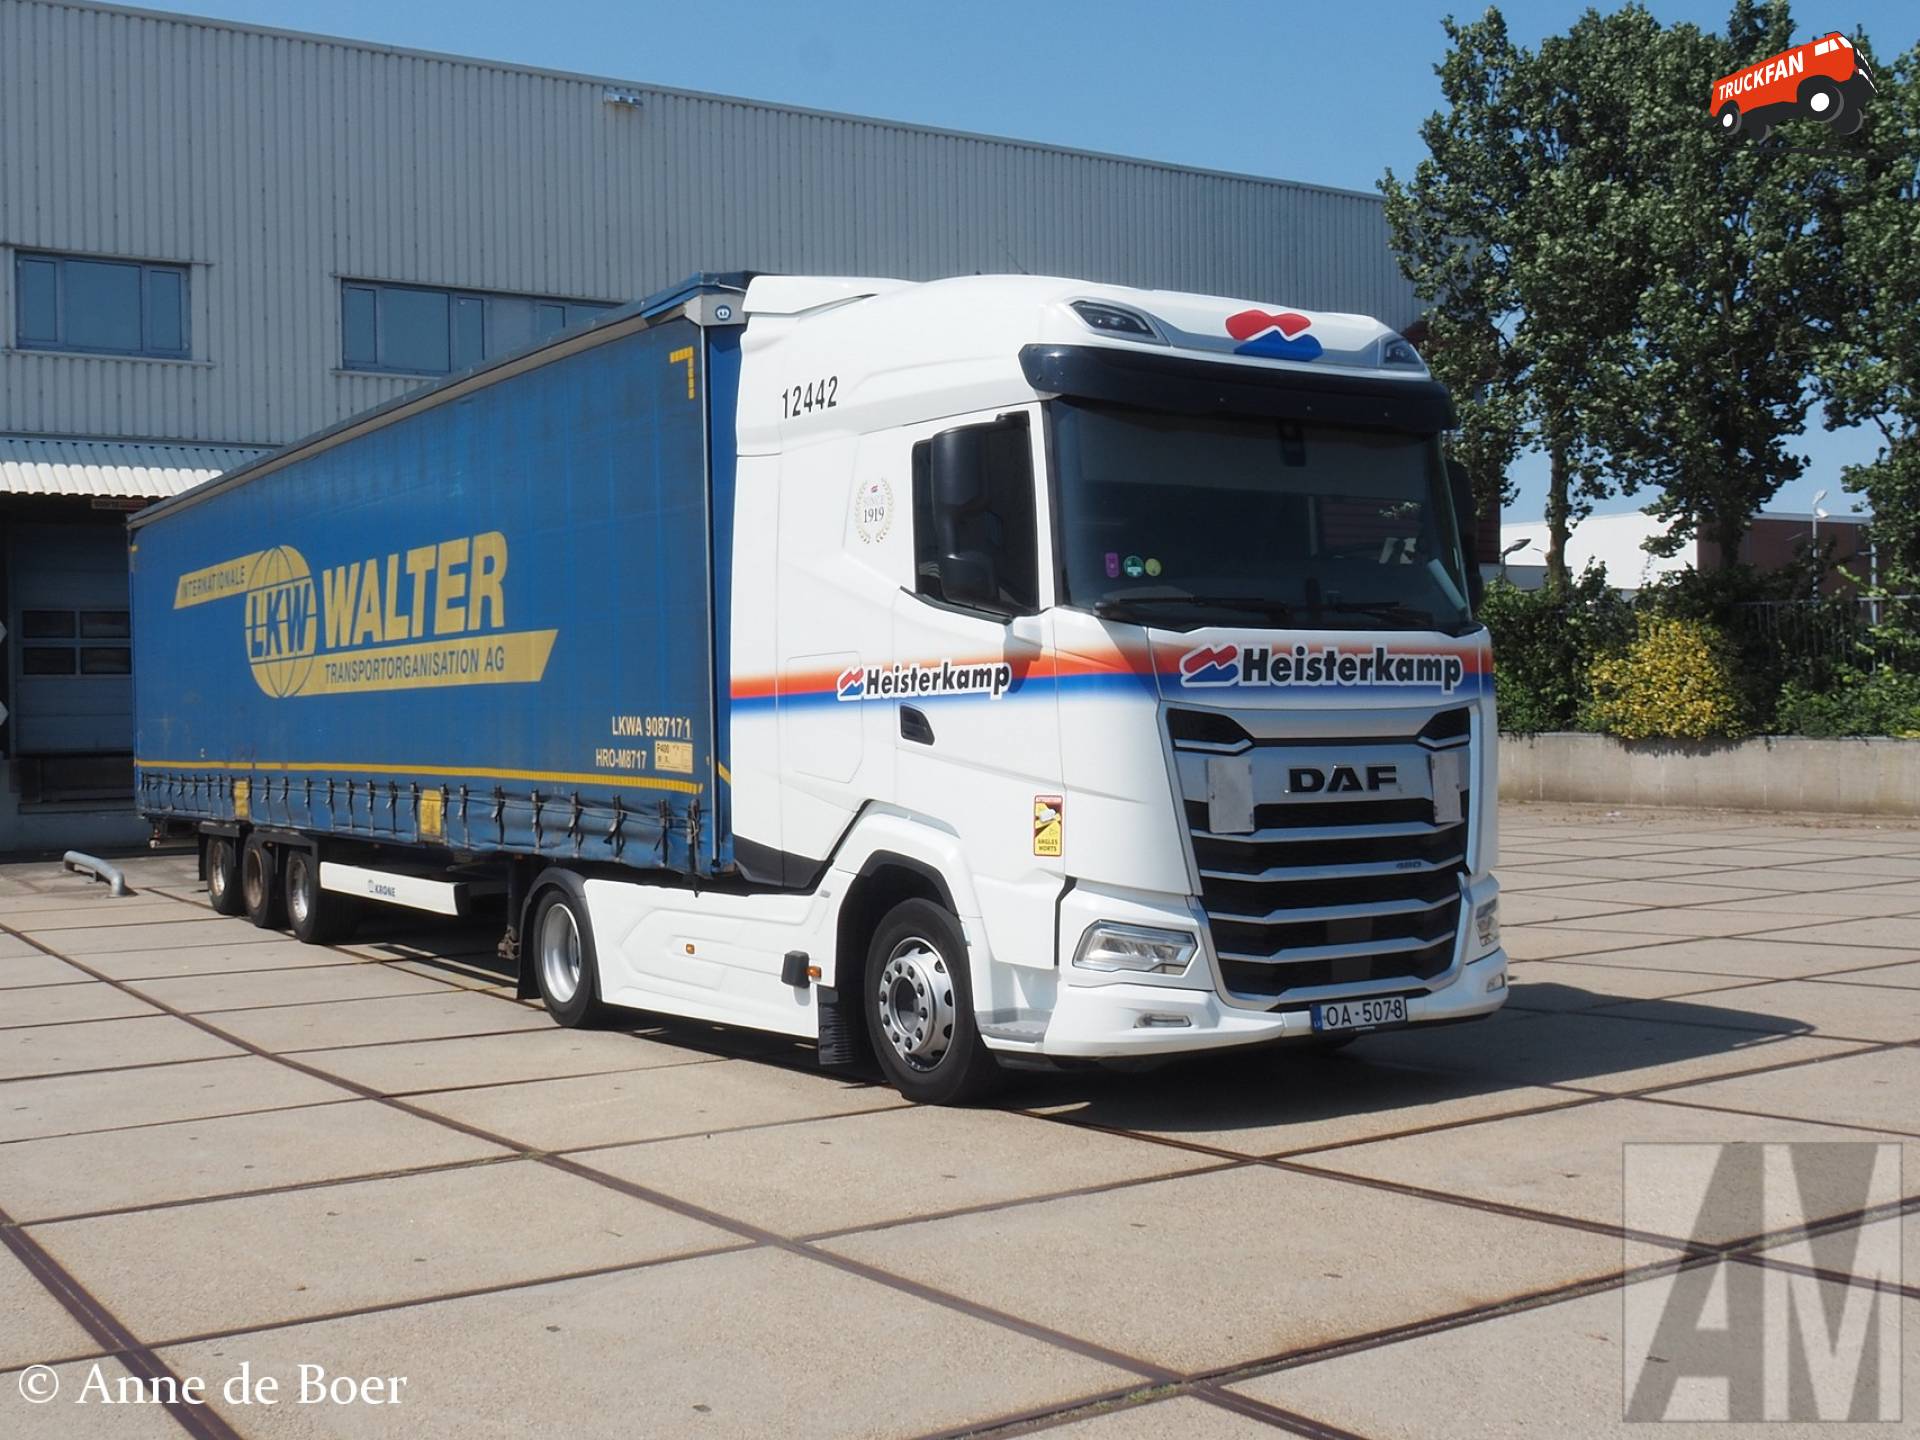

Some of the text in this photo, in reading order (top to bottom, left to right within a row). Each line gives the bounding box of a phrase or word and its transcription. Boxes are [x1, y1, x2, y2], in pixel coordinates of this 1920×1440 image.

[781, 376, 838, 419] 12442
[864, 507, 884, 523] 1919
[180, 564, 245, 598] INTERNATIONALE
[322, 530, 507, 649] WALTER
[251, 582, 311, 658] LKW
[325, 646, 504, 684] TRANSPORTORGANISATION AG
[866, 662, 1010, 696] Heisterkamp
[1242, 645, 1462, 692] Heisterkamp
[612, 715, 691, 739] LKWA 9087171
[595, 747, 647, 769] HRO-M8717
[1288, 765, 1398, 793] DAF
[1326, 999, 1404, 1027] OA-5078
